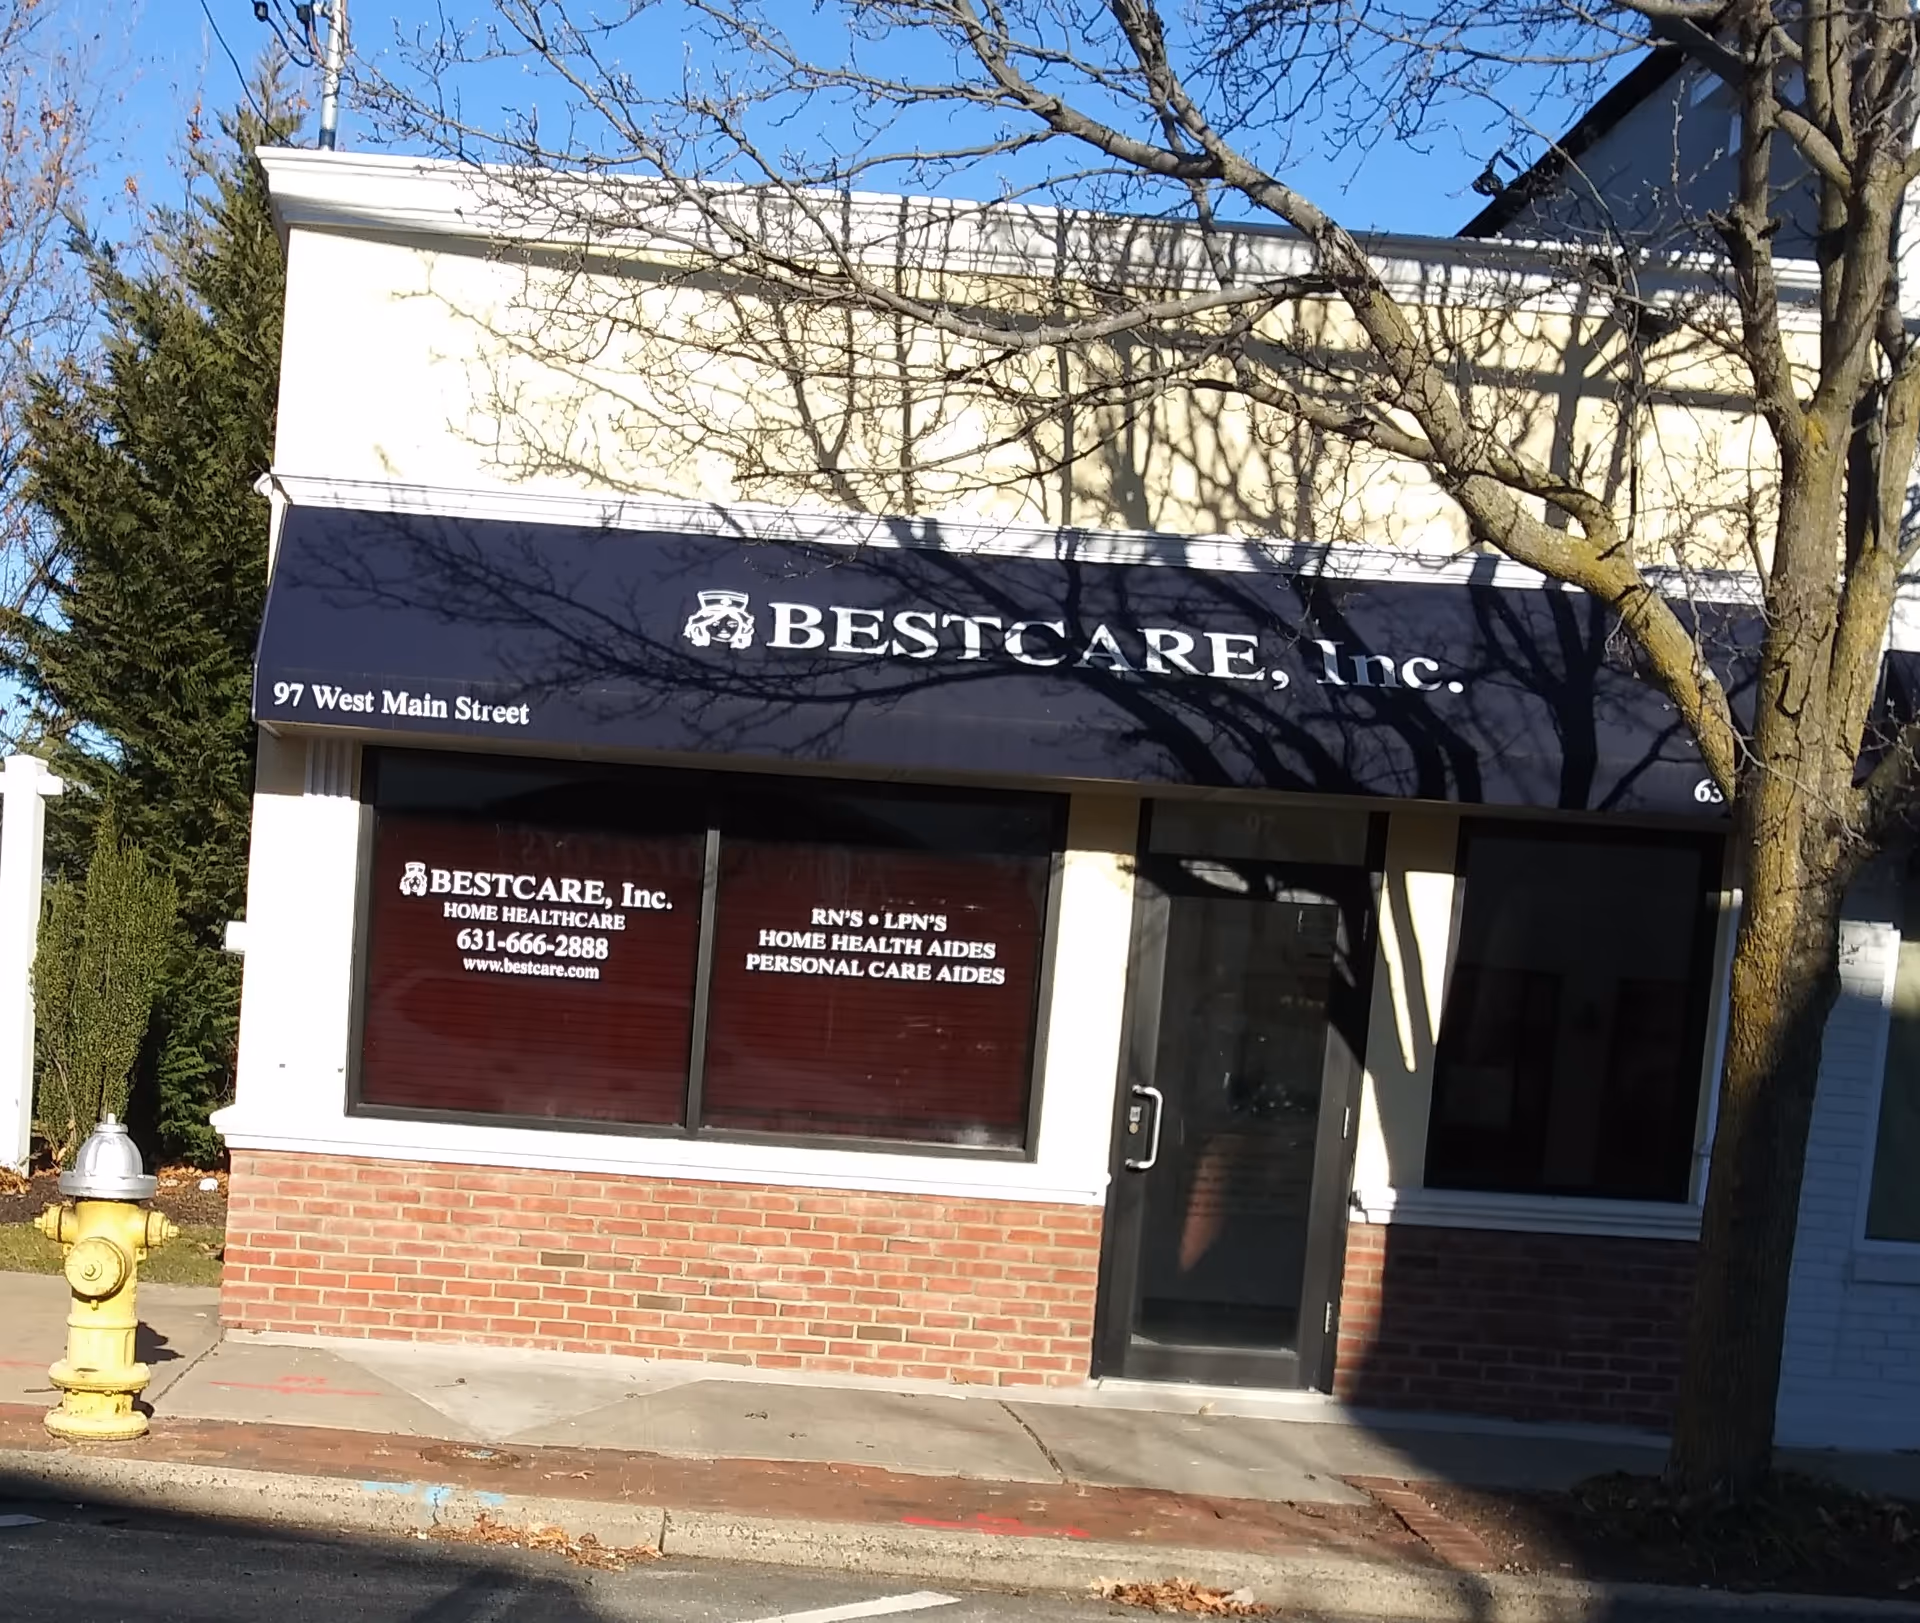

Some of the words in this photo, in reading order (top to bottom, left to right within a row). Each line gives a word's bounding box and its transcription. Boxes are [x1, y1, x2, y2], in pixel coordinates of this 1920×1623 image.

[765, 601, 1291, 691] BESTCARE,
[1314, 638, 1465, 695] Inc.
[273, 681, 304, 707] 97
[312, 684, 375, 713] West
[382, 690, 448, 718] Main
[455, 696, 530, 725] Street
[429, 868, 614, 910] BESTCARE,
[620, 882, 674, 910] Inc.
[443, 902, 499, 921] HOME
[501, 906, 626, 931] HEALTHCARE
[811, 907, 863, 928] RN'S
[884, 912, 948, 932] LPN'S
[456, 928, 609, 960] 631-666-2888
[758, 929, 827, 950] HOME
[831, 933, 923, 956] HEALTH
[927, 940, 997, 960] AIDES
[463, 957, 600, 980] www.bestcare.com
[745, 953, 865, 978] PERSONAL
[868, 961, 932, 981] CARE
[935, 964, 1006, 985] AIDES
